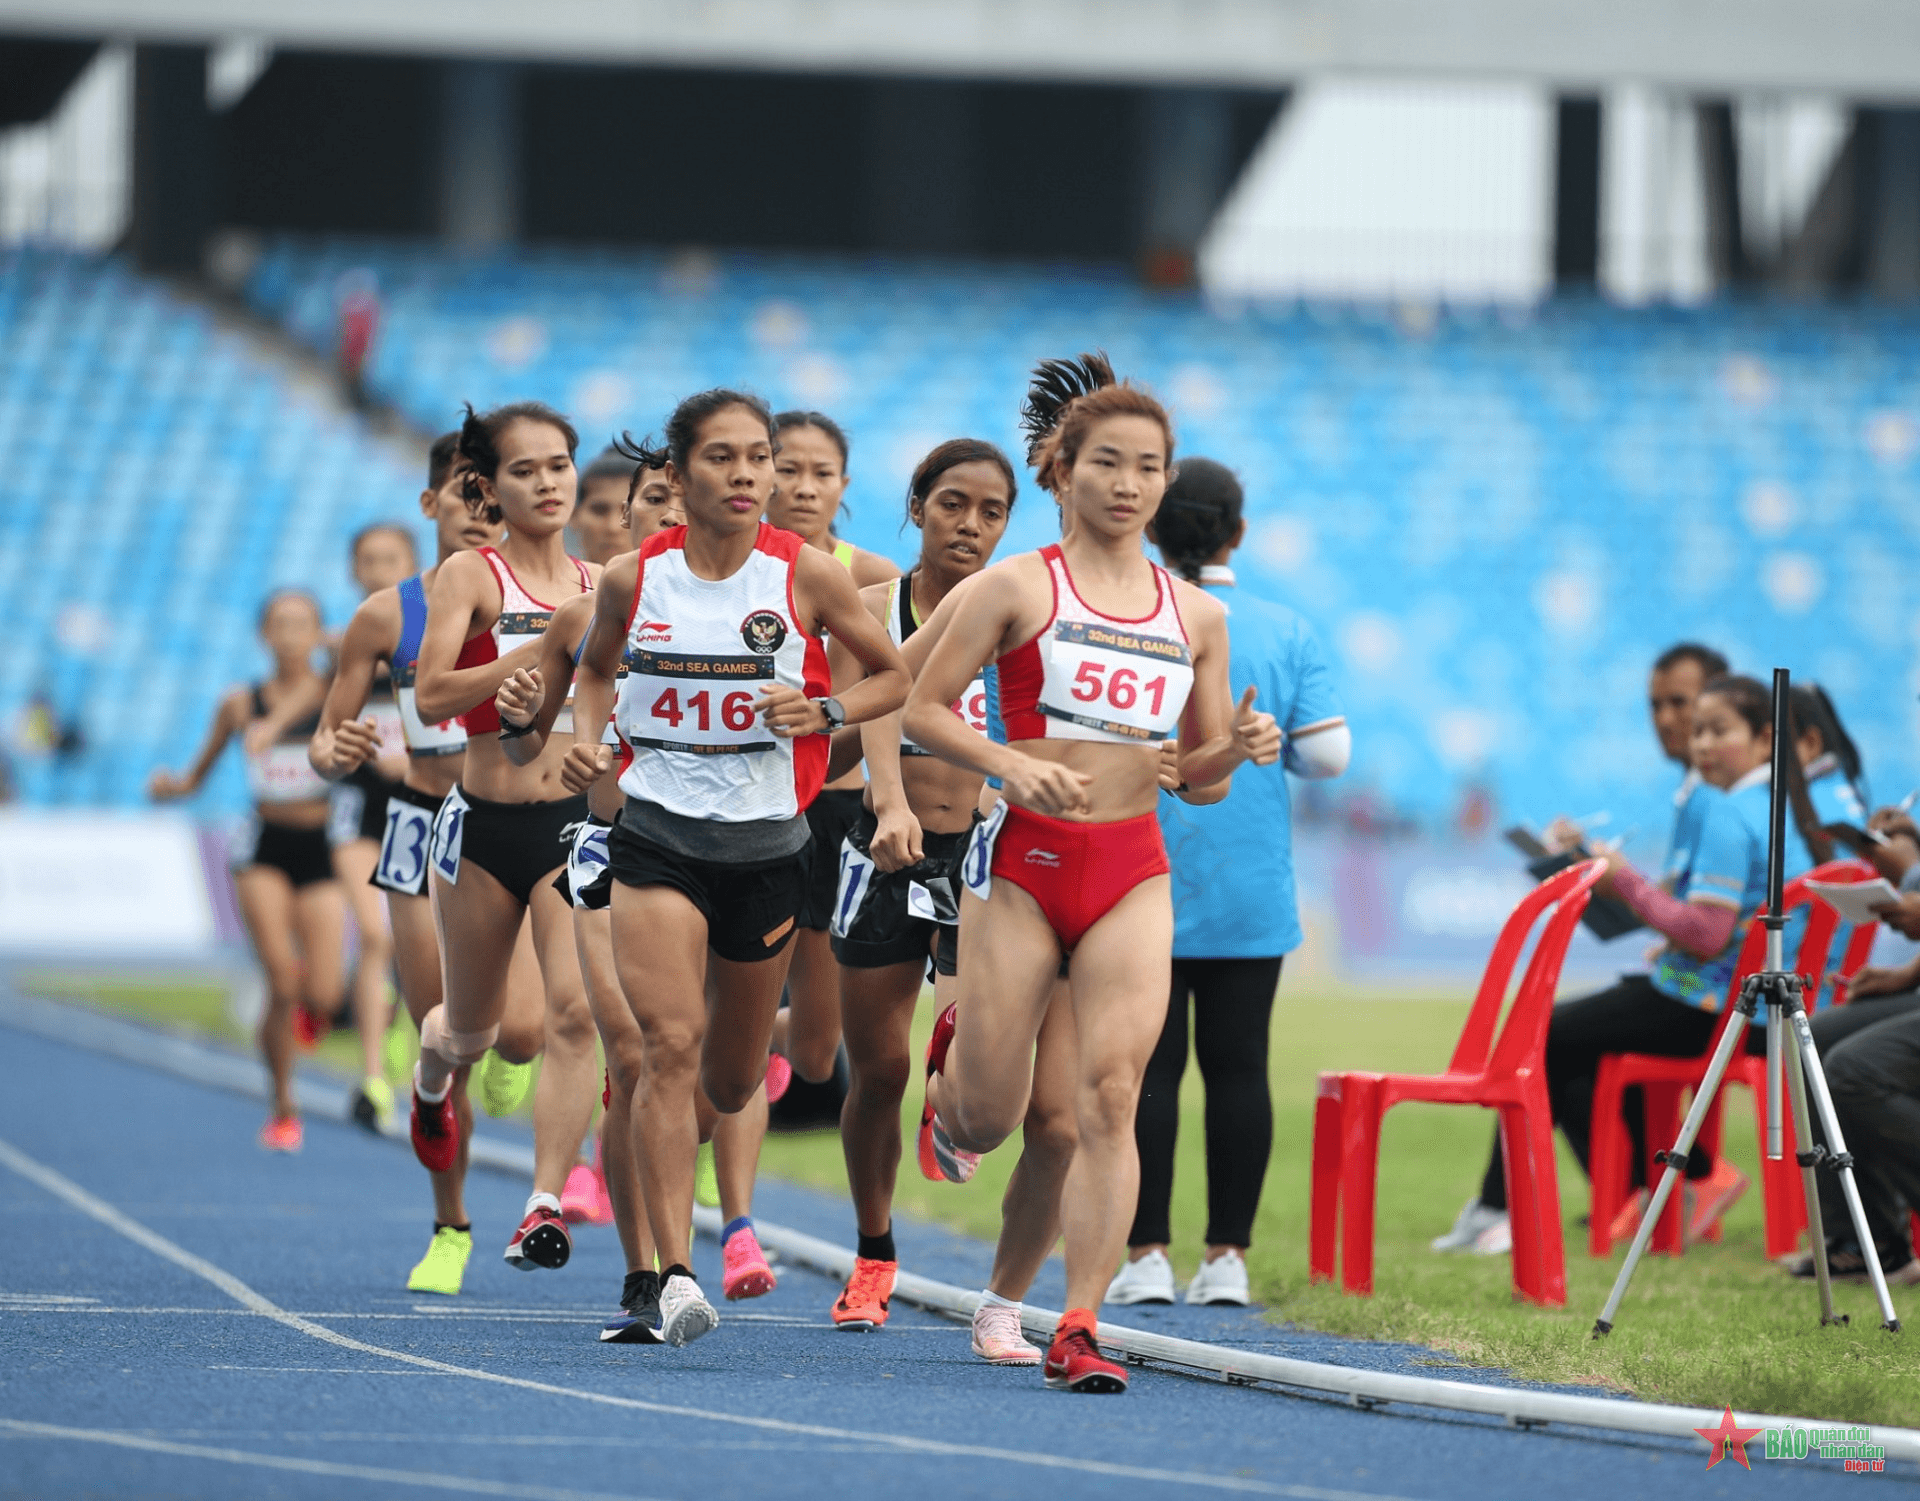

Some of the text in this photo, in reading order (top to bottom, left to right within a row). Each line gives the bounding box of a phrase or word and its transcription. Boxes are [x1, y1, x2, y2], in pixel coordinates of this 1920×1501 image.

[530, 618, 549, 628] 32n
[1087, 629, 1182, 658] 32nd SEA GAMES
[656, 660, 757, 674] 32nd SEA GAMES
[1070, 661, 1167, 716] 561
[651, 687, 756, 732] 416
[381, 810, 427, 883] 13
